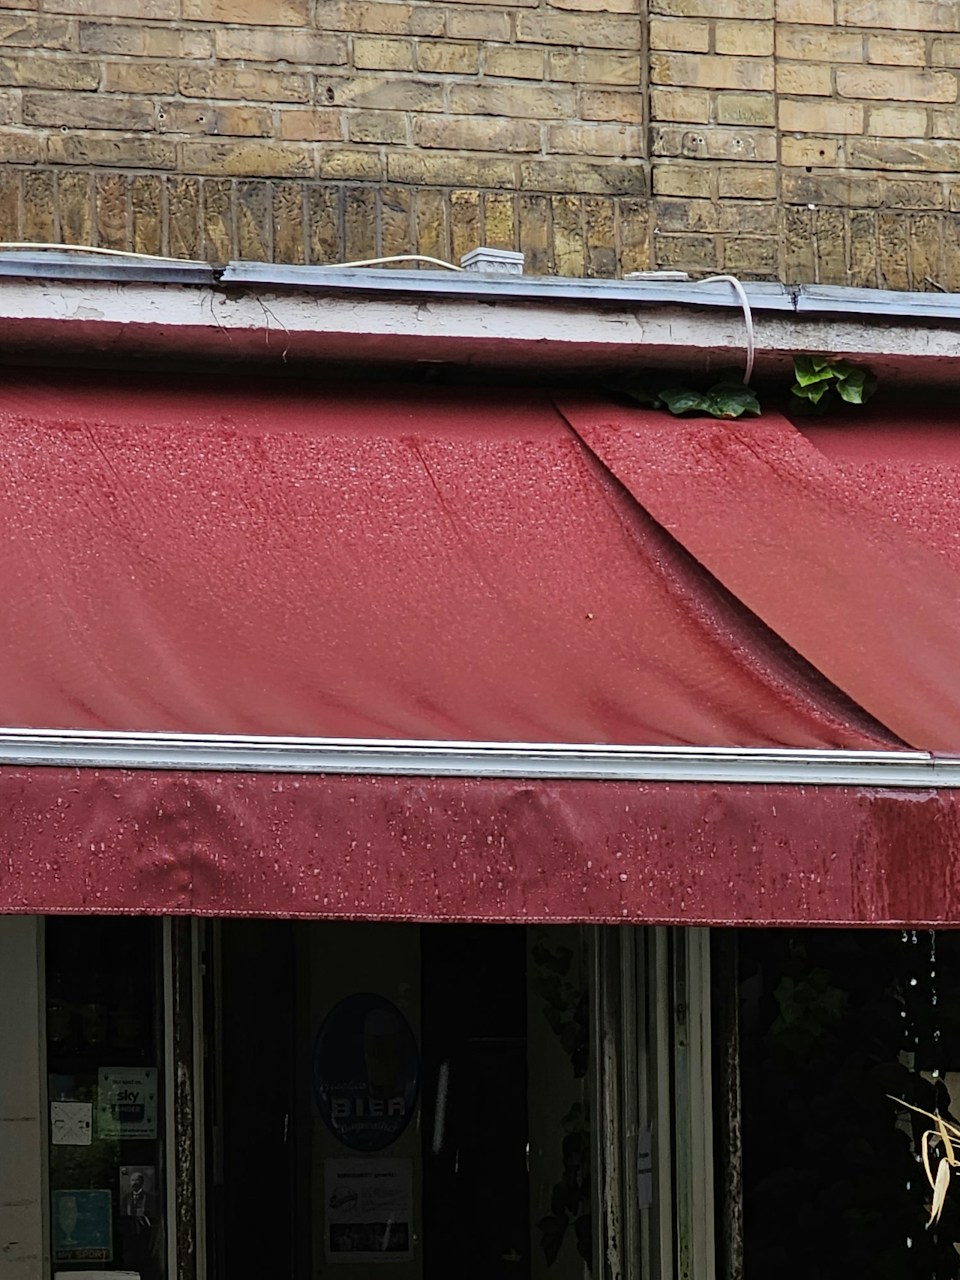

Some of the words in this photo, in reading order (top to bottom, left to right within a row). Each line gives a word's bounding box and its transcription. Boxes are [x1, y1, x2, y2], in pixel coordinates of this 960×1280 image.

[117, 1089, 140, 1103] sky
[331, 1097, 406, 1118] BIER
[78, 1249, 108, 1259] SPORT
